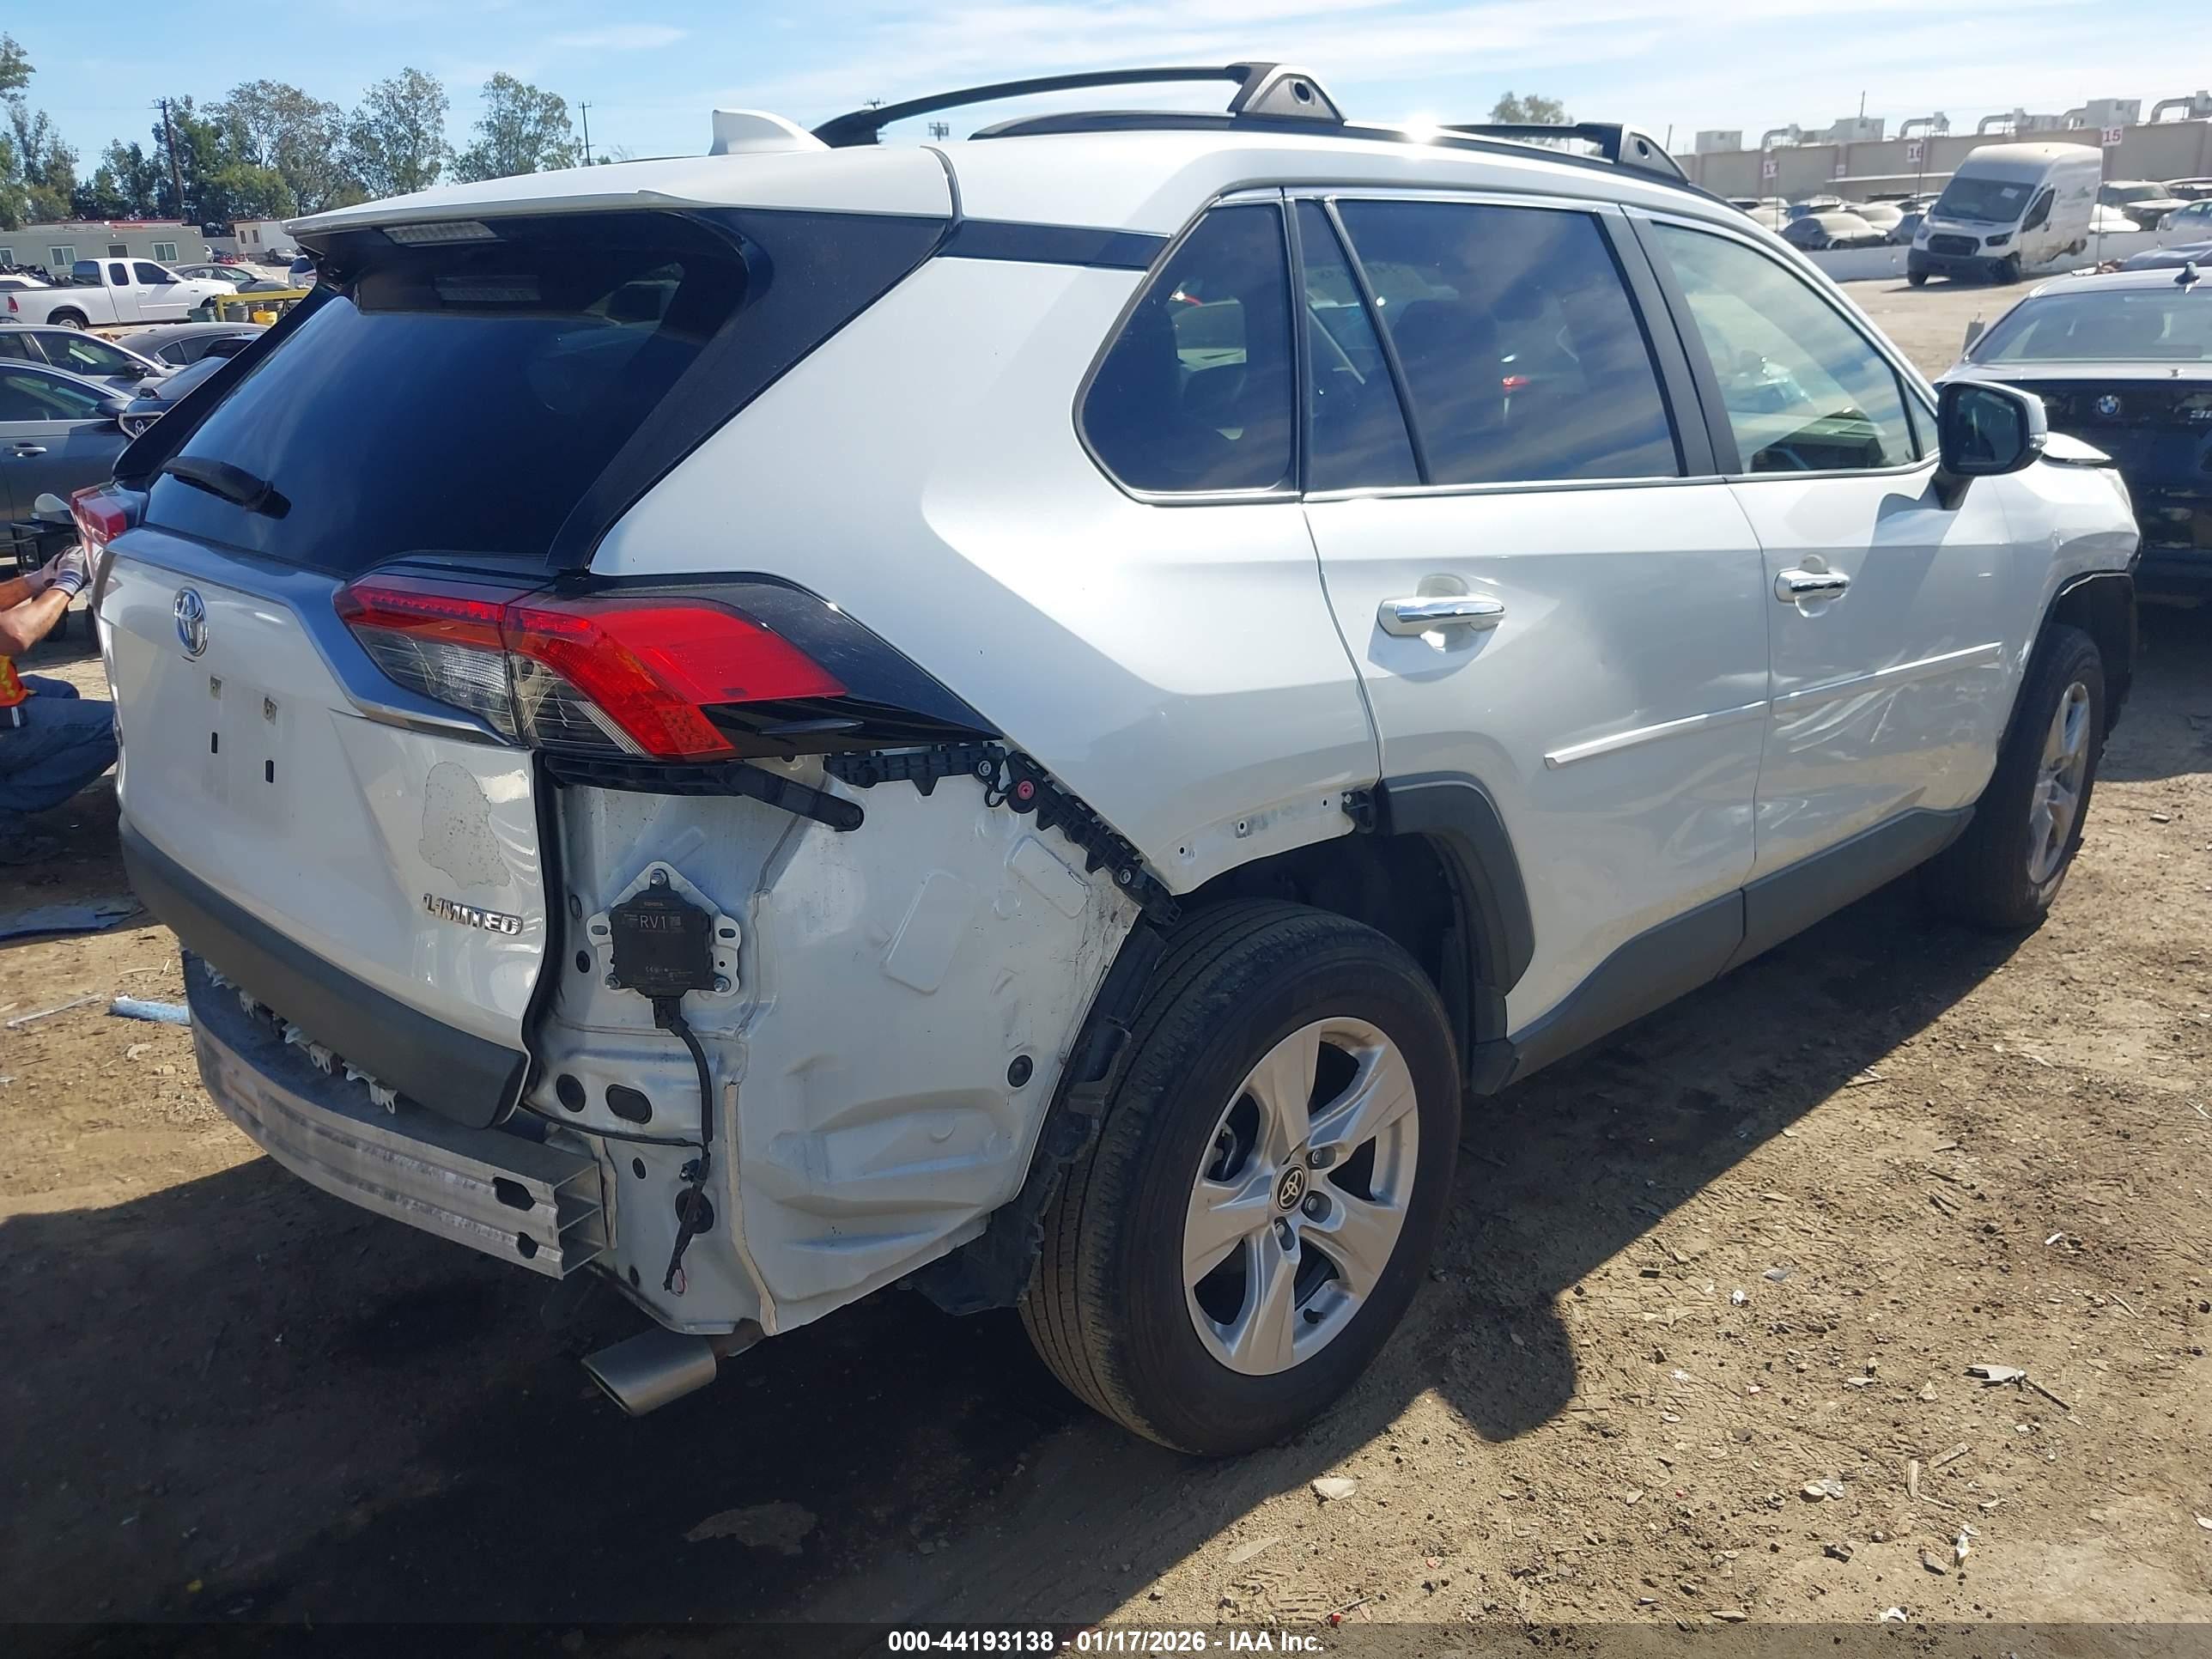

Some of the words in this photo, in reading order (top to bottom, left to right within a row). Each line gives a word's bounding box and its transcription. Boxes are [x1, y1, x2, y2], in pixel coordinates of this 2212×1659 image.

[2104, 129, 2121, 143] 15
[422, 893, 523, 935] LIMITED
[640, 915, 666, 929] RV1
